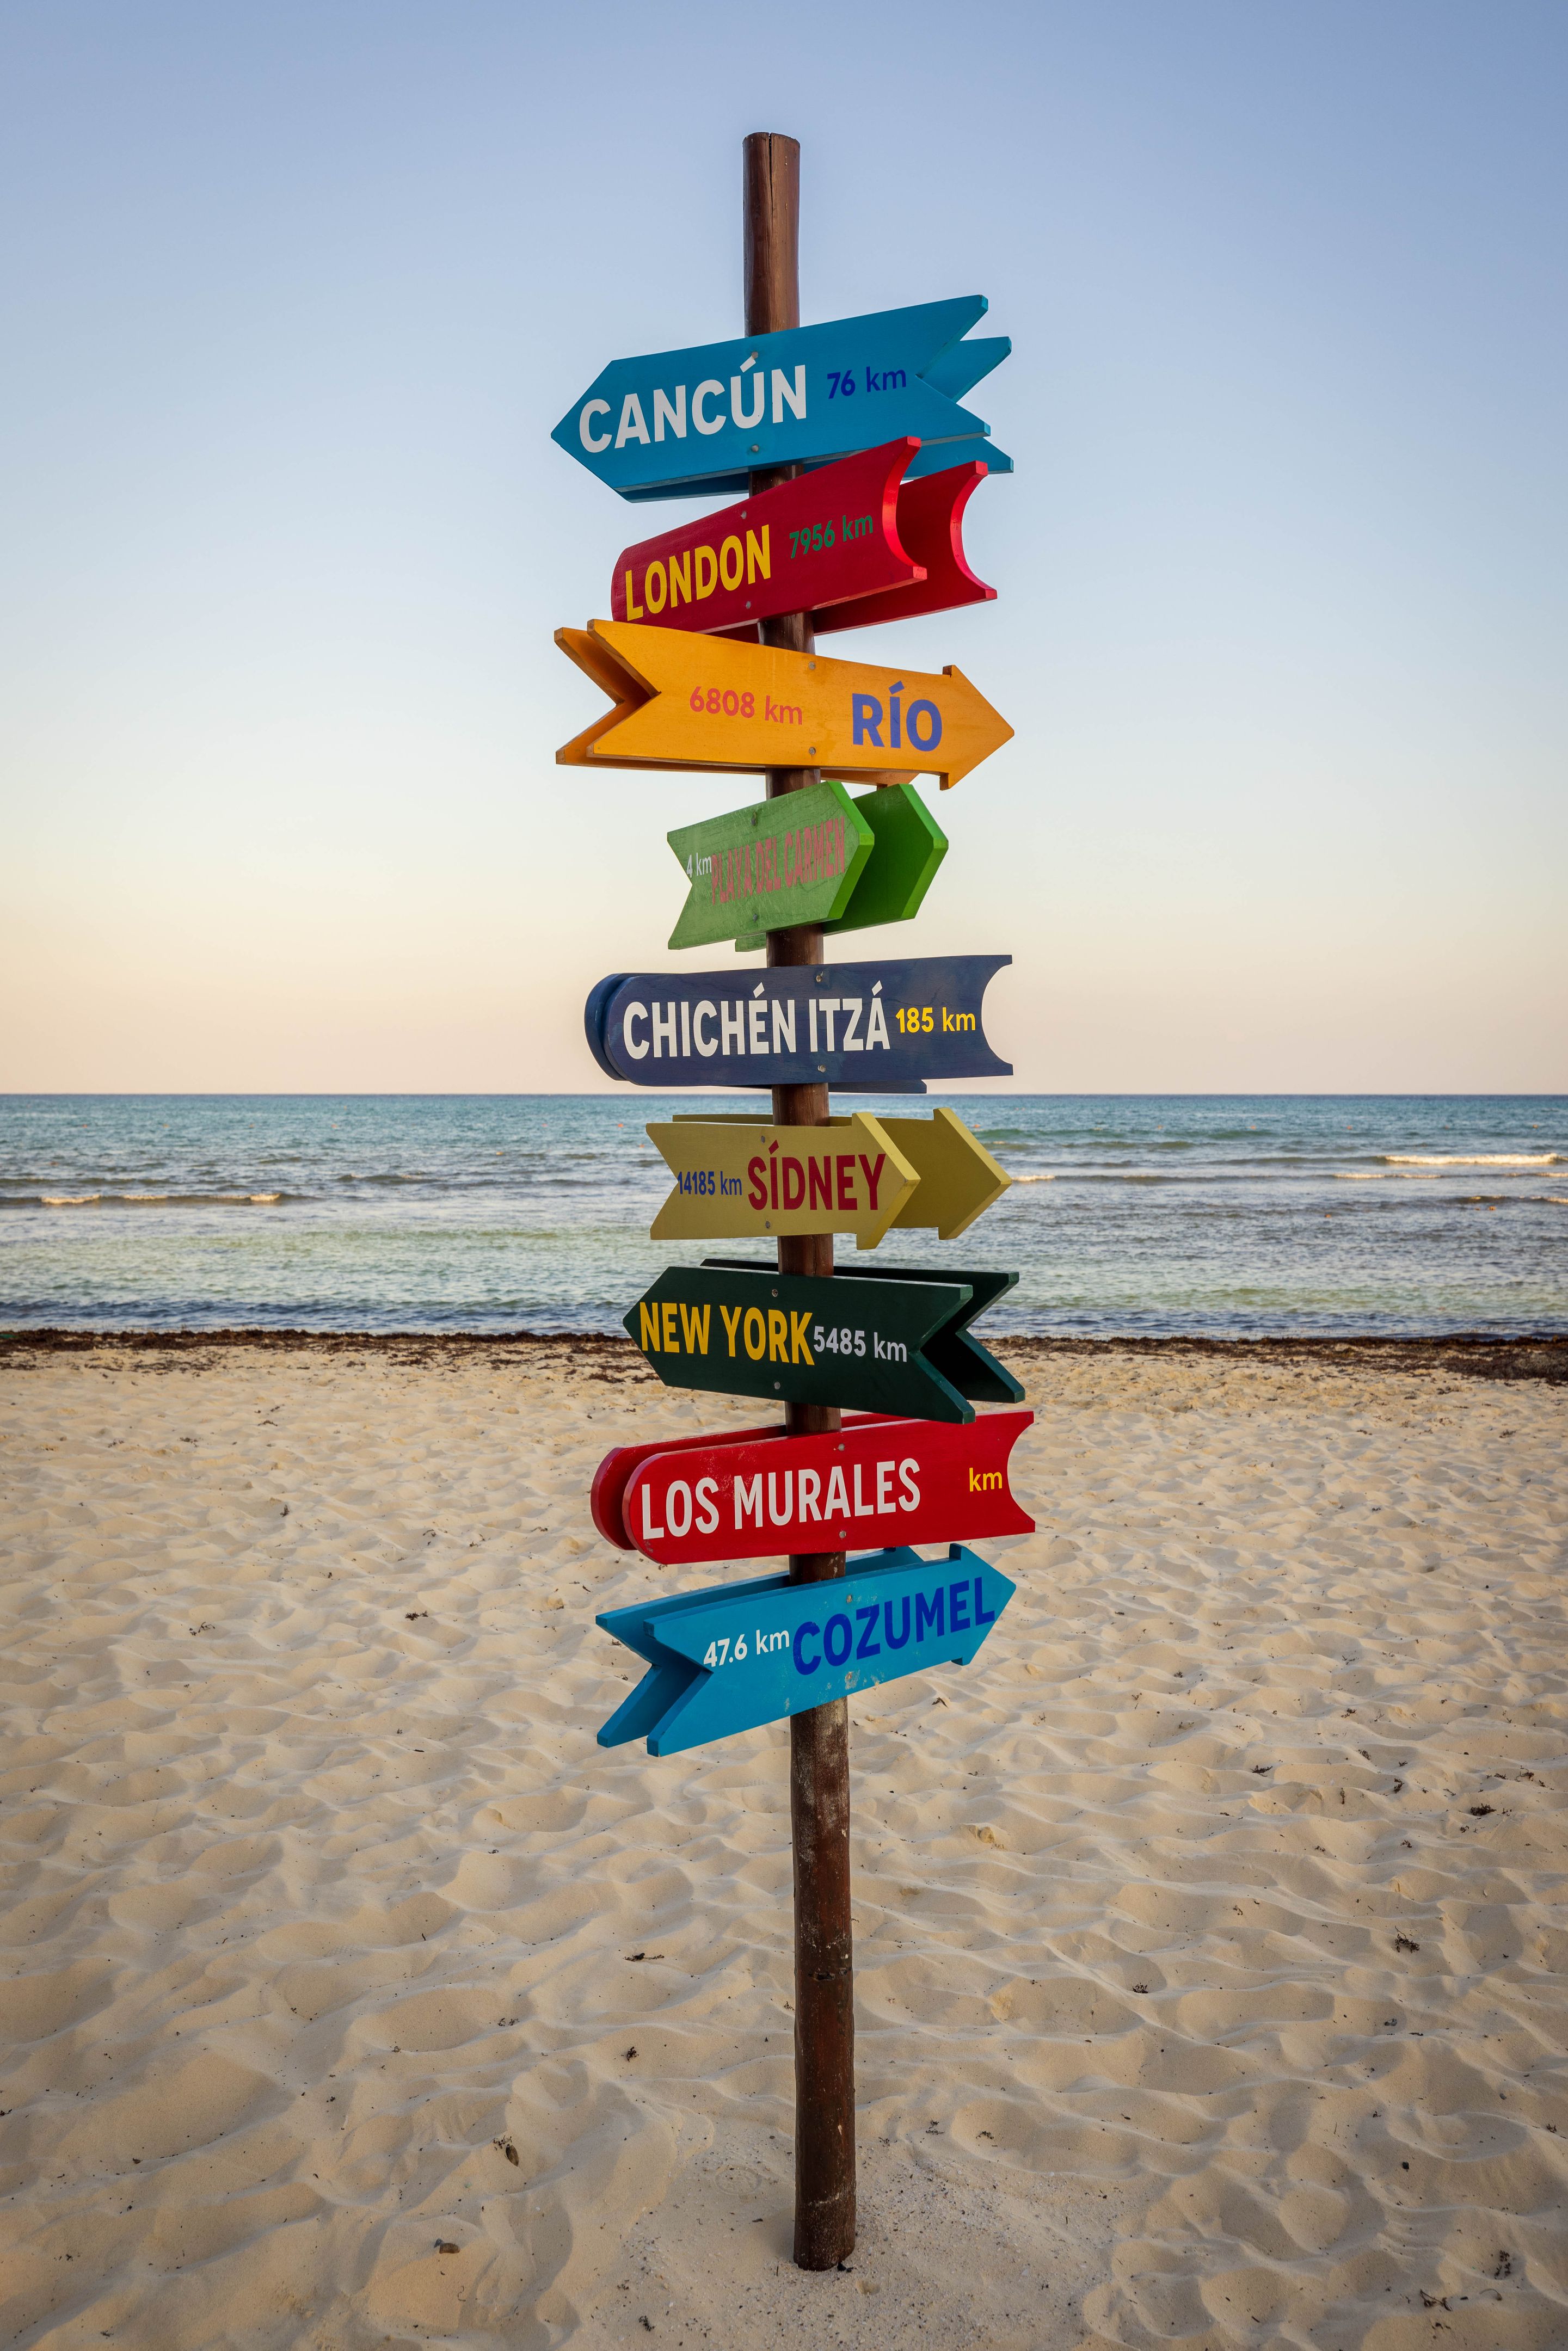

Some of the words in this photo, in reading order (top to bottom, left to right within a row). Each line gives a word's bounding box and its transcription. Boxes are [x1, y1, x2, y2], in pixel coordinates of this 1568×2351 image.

[580, 356, 806, 453] CANCÚN
[827, 371, 855, 399] 76
[866, 366, 906, 392] km
[625, 525, 771, 620] LONDON
[789, 520, 835, 559] 7956
[843, 514, 874, 542] km
[690, 686, 755, 718] 6808
[765, 695, 802, 725] km
[852, 680, 942, 752] RÍO
[686, 854, 693, 878] 4
[696, 853, 712, 876] km
[711, 845, 752, 906] PLAYA
[755, 836, 781, 894] DEL
[784, 816, 845, 888] CARMEN
[623, 982, 796, 1060] CHICHÉN
[809, 980, 890, 1052] ITZÁ
[895, 1007, 933, 1033] 185
[943, 1007, 976, 1032] km
[677, 1171, 715, 1196] 14185
[721, 1171, 742, 1196] km
[748, 1140, 886, 1211] SÍDNEY
[640, 1302, 710, 1355] NEW
[720, 1306, 815, 1366] YORK
[813, 1326, 866, 1357] 5485
[874, 1332, 907, 1362] km
[642, 1477, 720, 1540] LOS
[734, 1458, 920, 1530] MURALES
[969, 1467, 1003, 1492] km
[703, 1634, 747, 1667] 47.6
[757, 1629, 790, 1655] km
[792, 1576, 995, 1675] COZUMEL
